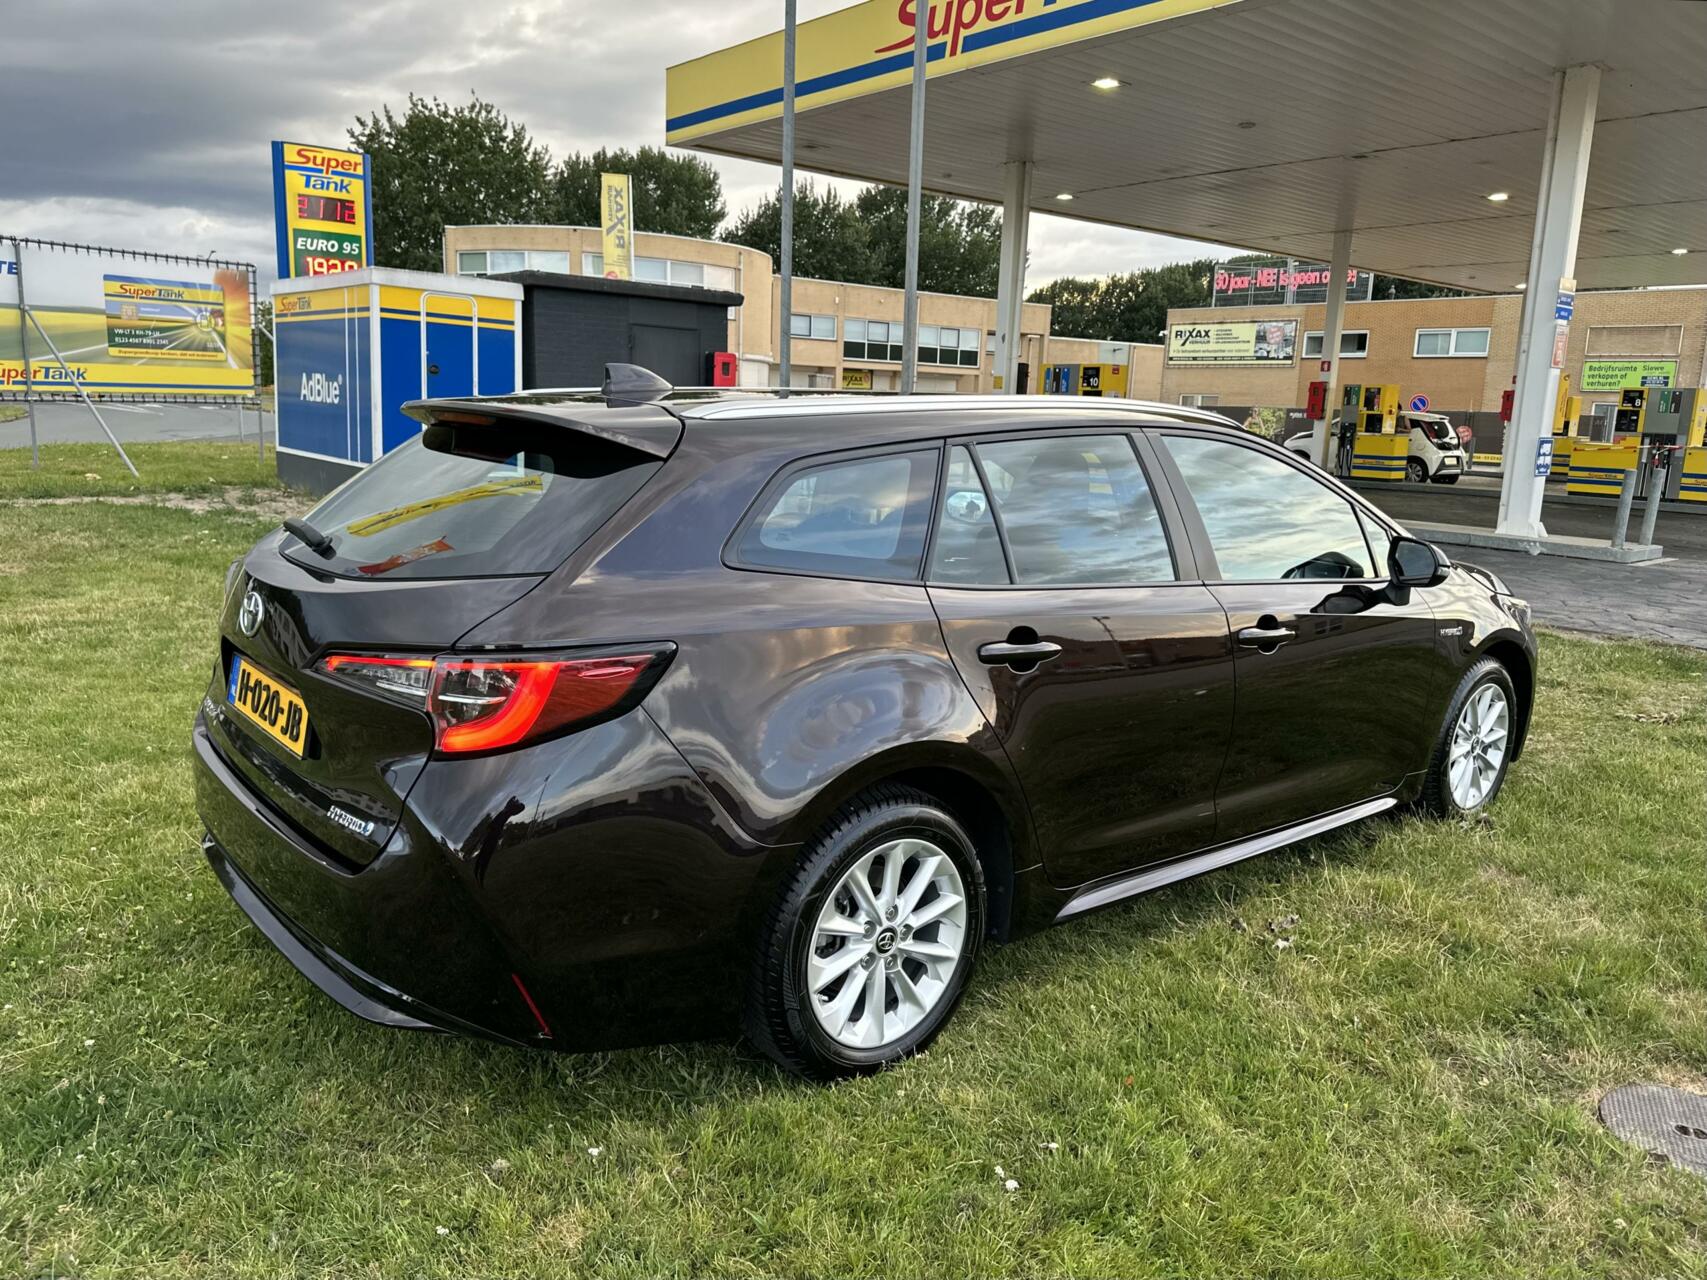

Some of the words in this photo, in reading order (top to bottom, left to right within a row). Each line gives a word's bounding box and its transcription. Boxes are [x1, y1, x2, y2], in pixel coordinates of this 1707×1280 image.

[285, 148, 362, 175] Super
[298, 173, 352, 193] Tank
[297, 237, 339, 252] EURO
[342, 242, 360, 254] 95
[118, 284, 185, 300] SuperTank
[0, 363, 87, 385] uperTank
[1588, 365, 1637, 373] Bedrijfsruimte
[1089, 377, 1099, 386] 10
[1634, 398, 1641, 406] 8
[238, 668, 302, 743] H-020-JB
[326, 805, 366, 833] HYBRID
